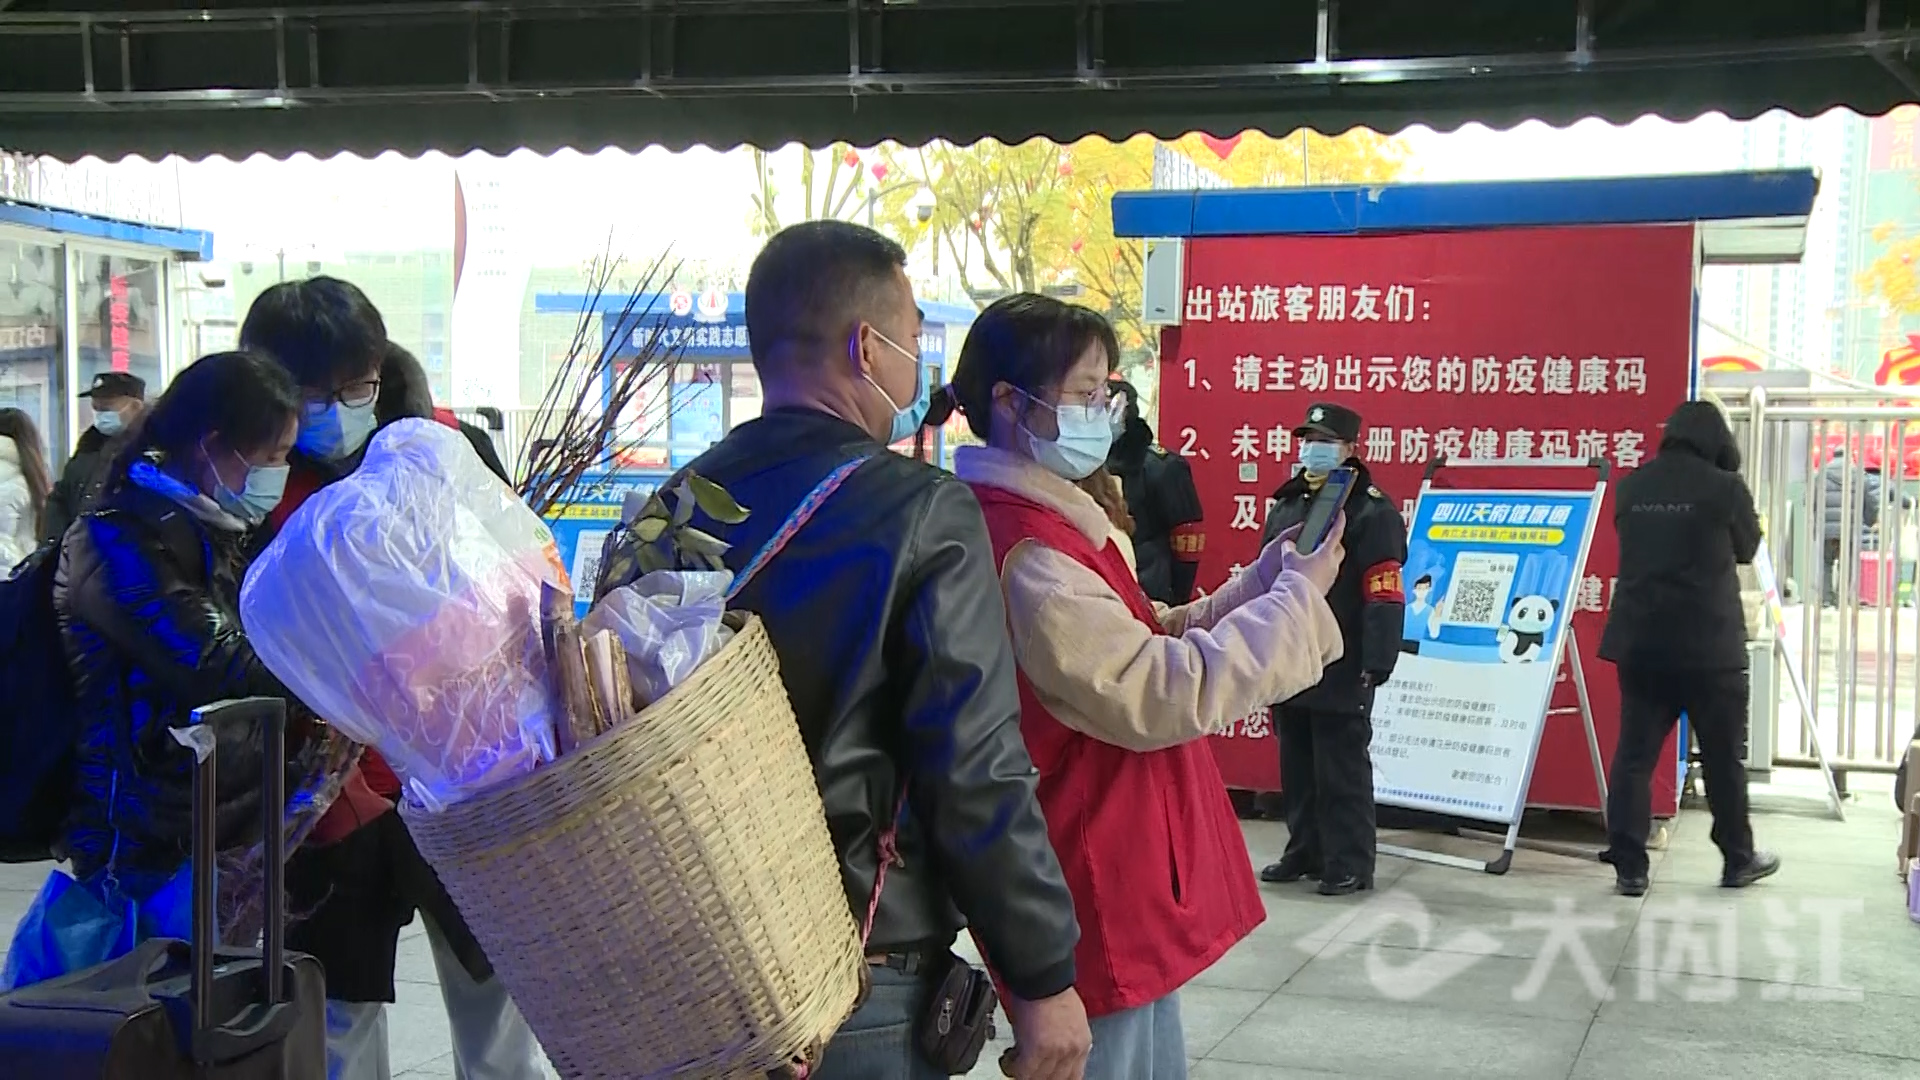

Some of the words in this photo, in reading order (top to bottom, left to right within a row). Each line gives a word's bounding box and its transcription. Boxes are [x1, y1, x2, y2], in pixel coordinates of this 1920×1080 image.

[1186, 284, 1430, 322] 出站旅客朋友们：
[1183, 356, 1648, 395] 1、请主动出示您的防疫健康码
[1180, 426, 1646, 469] 2、未申册防疫健康码旅客
